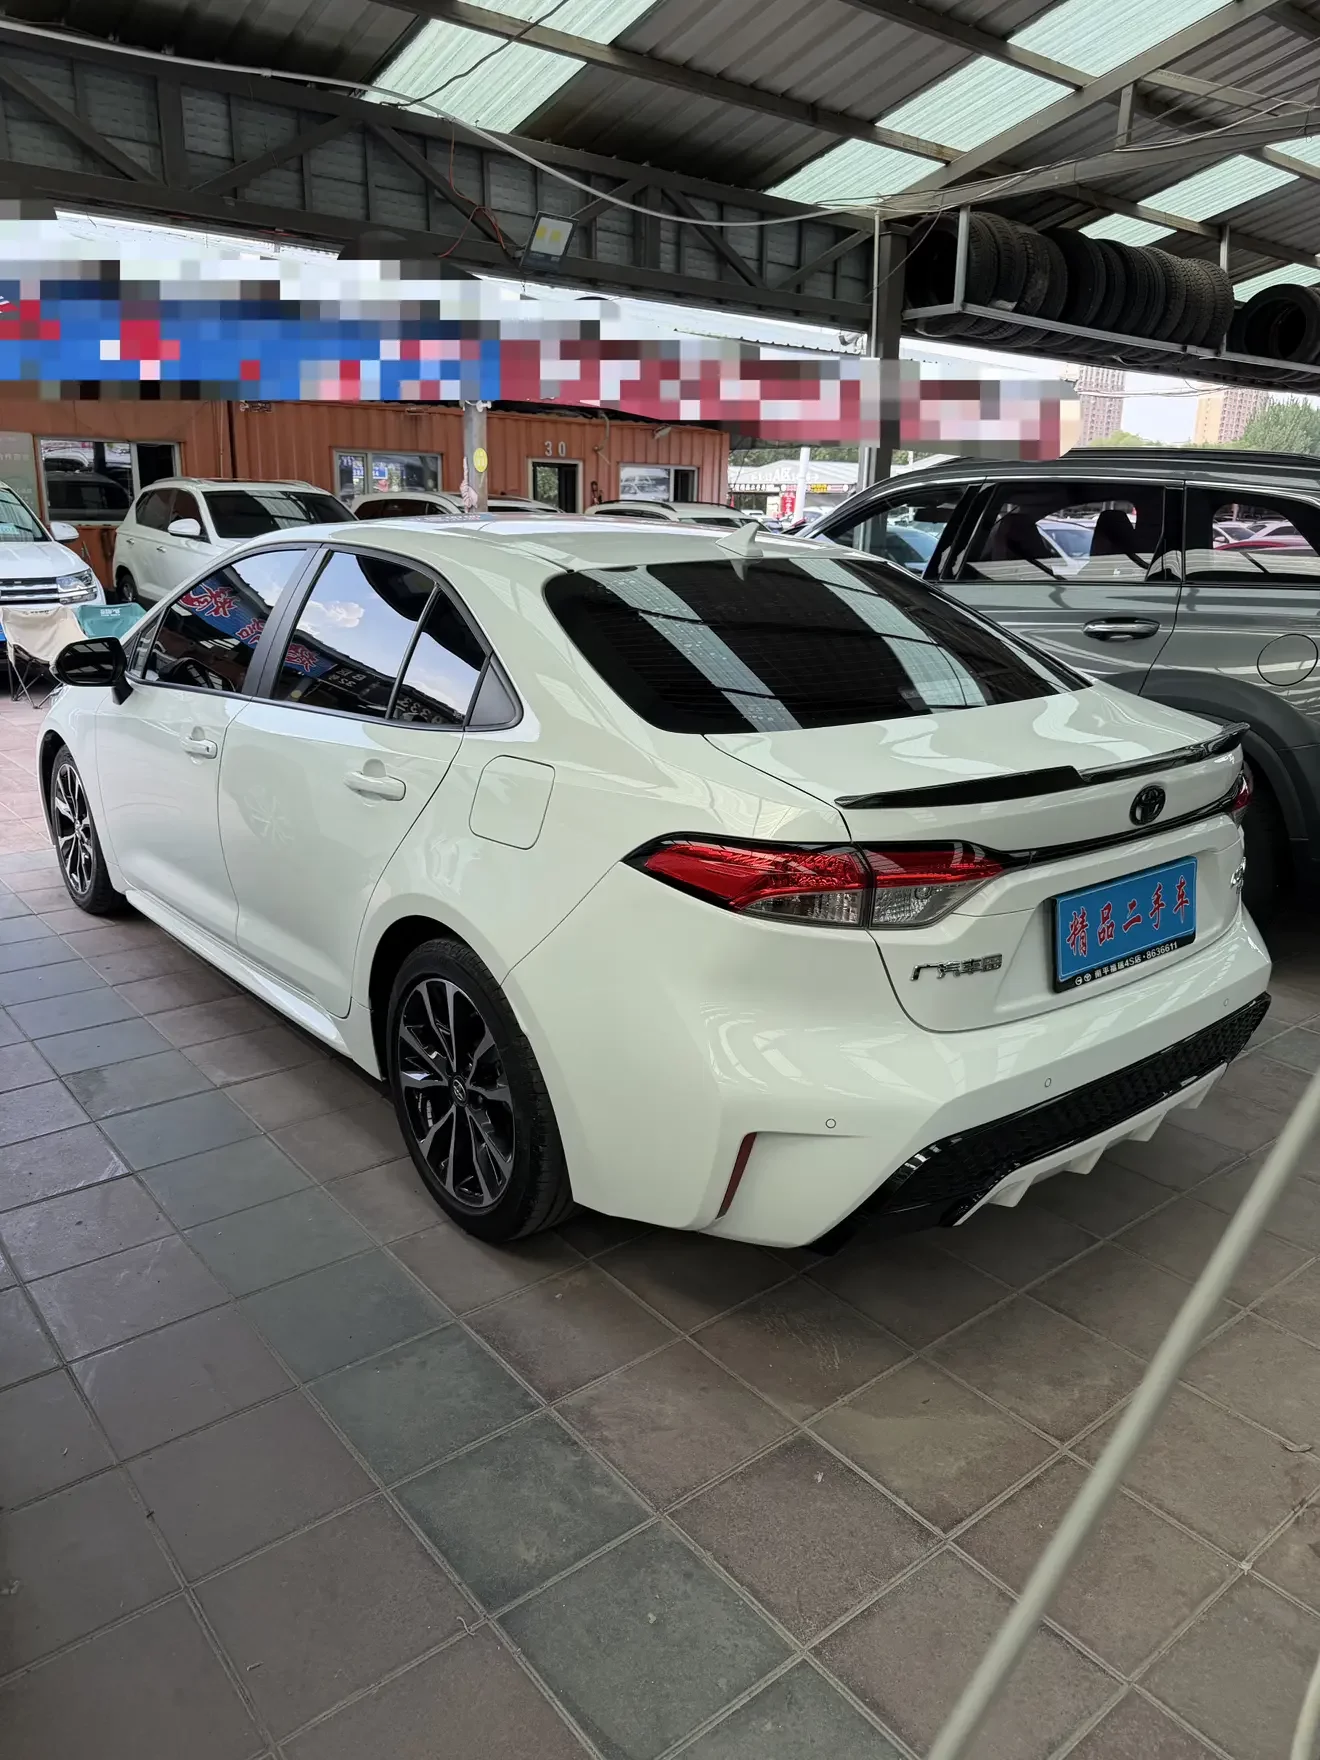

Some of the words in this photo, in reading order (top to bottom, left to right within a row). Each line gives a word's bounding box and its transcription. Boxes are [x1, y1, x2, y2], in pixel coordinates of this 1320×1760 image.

[544, 440, 566, 457] 30
[1066, 874, 1190, 958] 精品二手车
